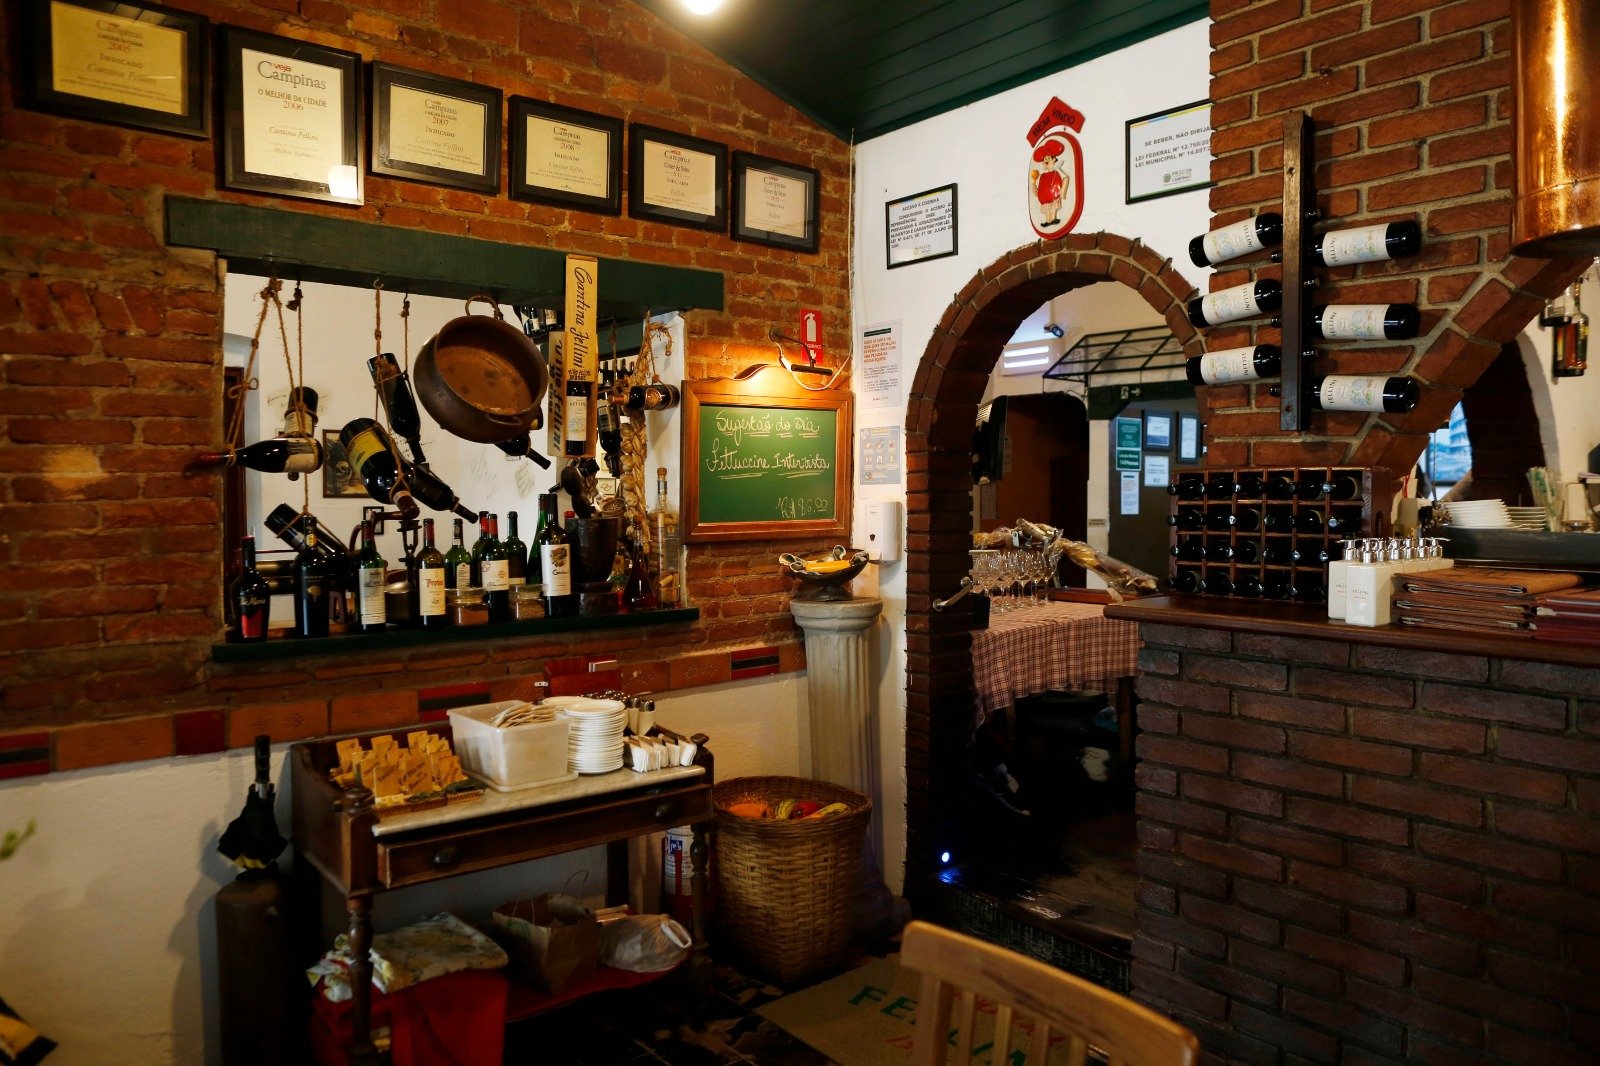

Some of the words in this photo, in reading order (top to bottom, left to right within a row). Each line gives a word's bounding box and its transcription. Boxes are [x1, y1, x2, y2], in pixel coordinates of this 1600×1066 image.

[257, 61, 326, 89] Campinas
[273, 63, 292, 72] veja
[264, 90, 292, 101] MELHOR
[303, 97, 327, 107] CIDADE
[283, 101, 304, 111] 2006
[1033, 115, 1051, 137] BEM
[1052, 107, 1076, 125] VINDO
[1145, 149, 1171, 159] FEDERAL
[1145, 155, 1177, 166] MUNICIPAL
[574, 266, 593, 326] Cantina
[569, 327, 590, 368] Fellini
[1241, 352, 1249, 377] FELLINI
[1327, 379, 1337, 405] FELLINI
[715, 410, 773, 446] Sugestão
[775, 416, 791, 431] do
